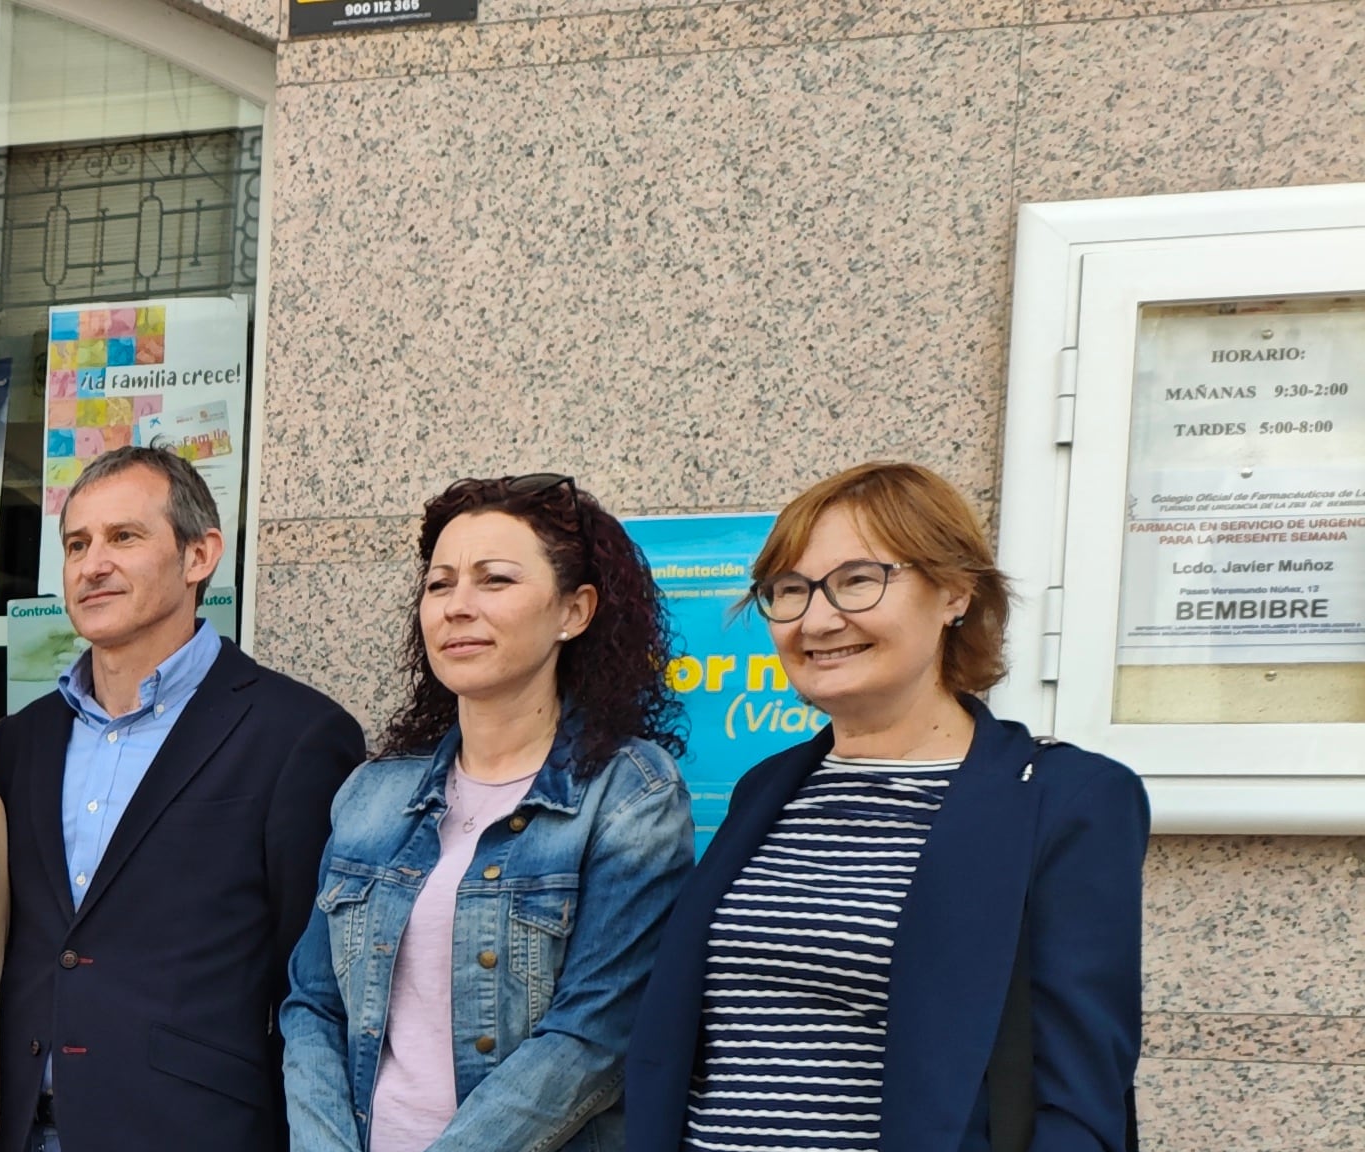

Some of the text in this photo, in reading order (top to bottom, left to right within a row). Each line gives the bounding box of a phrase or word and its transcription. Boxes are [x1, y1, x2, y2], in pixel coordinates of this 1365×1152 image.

[1211, 347, 1306, 363] HORARIO:
[181, 362, 242, 386] crece!
[1165, 383, 1349, 401] MAÑANAS 9:30-2:00
[1174, 420, 1334, 437] TARDES 5:00-8:00
[1152, 494, 1193, 505] Colegio
[1196, 492, 1232, 502] Oficial
[1234, 492, 1248, 501] de
[1251, 490, 1335, 500] Farmacéuticos
[1338, 490, 1353, 498] de
[1130, 521, 1196, 533] FARMACIA
[1199, 521, 1217, 531] EN
[1220, 519, 1283, 531] SERVICIO
[1287, 519, 1305, 529] DE
[1159, 531, 1347, 545] PARA LA PRESENTE SEMANA
[1172, 558, 1334, 574] Lcdo. Javier Muñoz
[10, 603, 63, 618] Controla
[1175, 598, 1330, 621] BEMBIBRE
